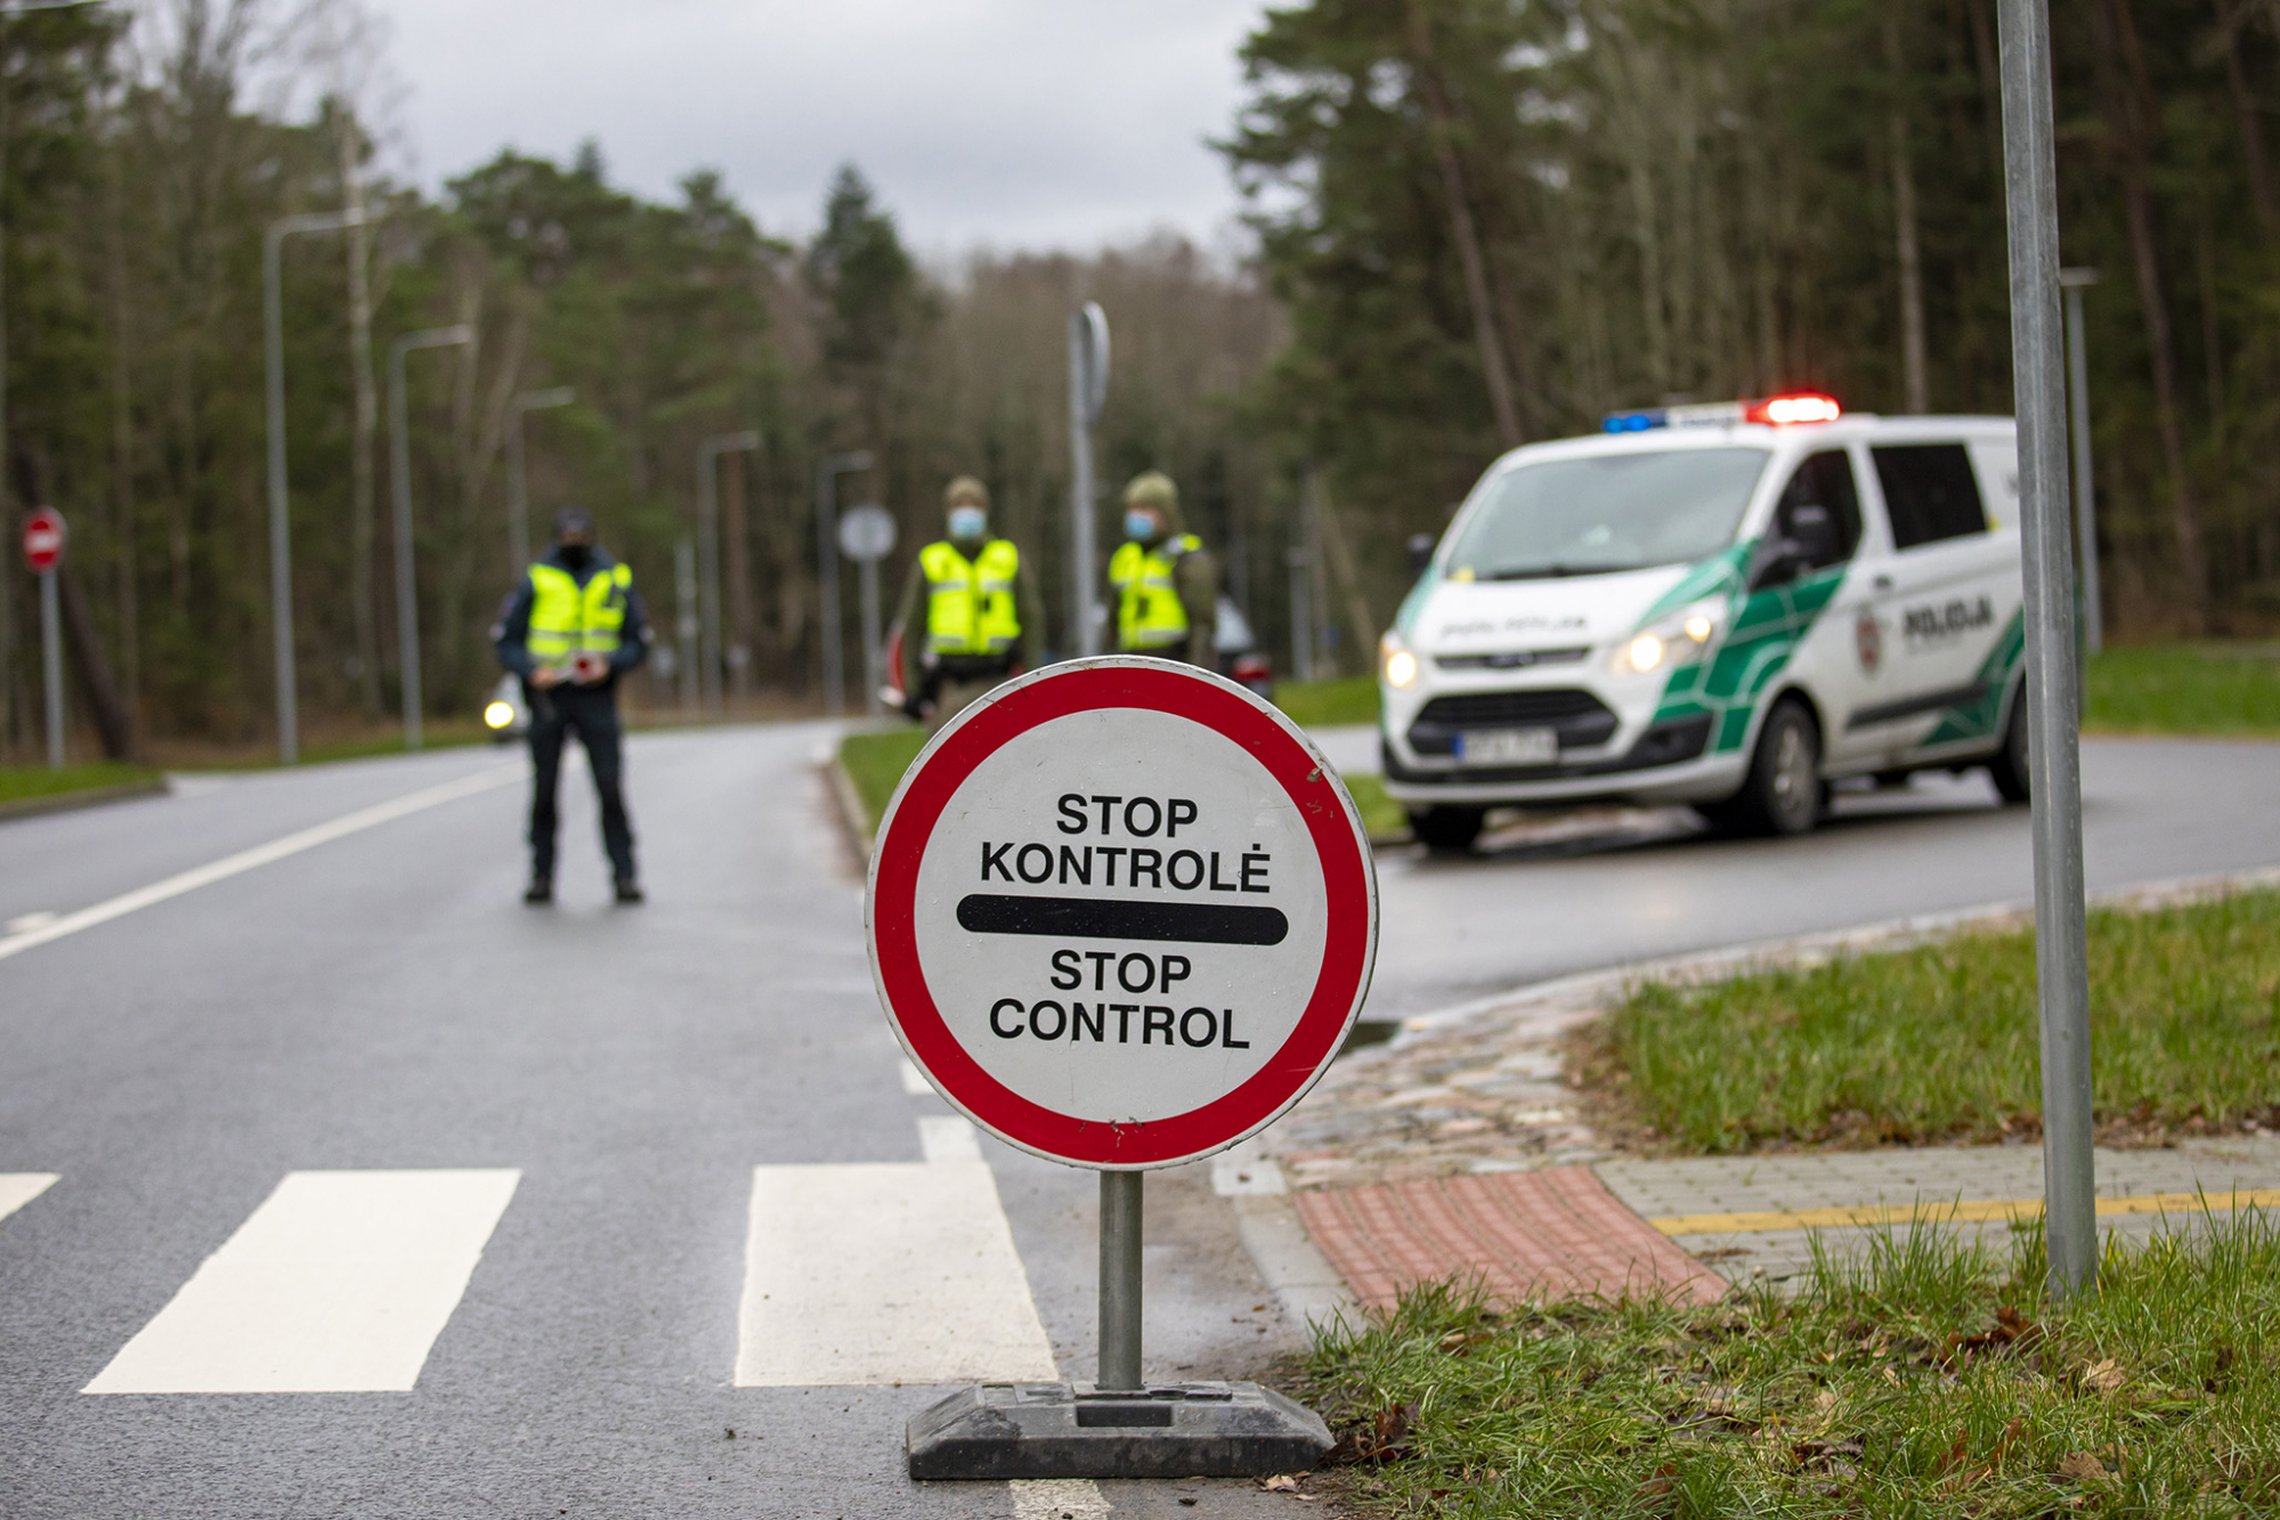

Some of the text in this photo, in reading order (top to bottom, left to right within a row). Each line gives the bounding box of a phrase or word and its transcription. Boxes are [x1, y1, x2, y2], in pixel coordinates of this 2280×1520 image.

[1056, 793, 1198, 838] STOP
[981, 841, 1271, 894] KONTROLĖ
[1050, 949, 1192, 994] STOP
[989, 997, 1250, 1050] CONTROL
